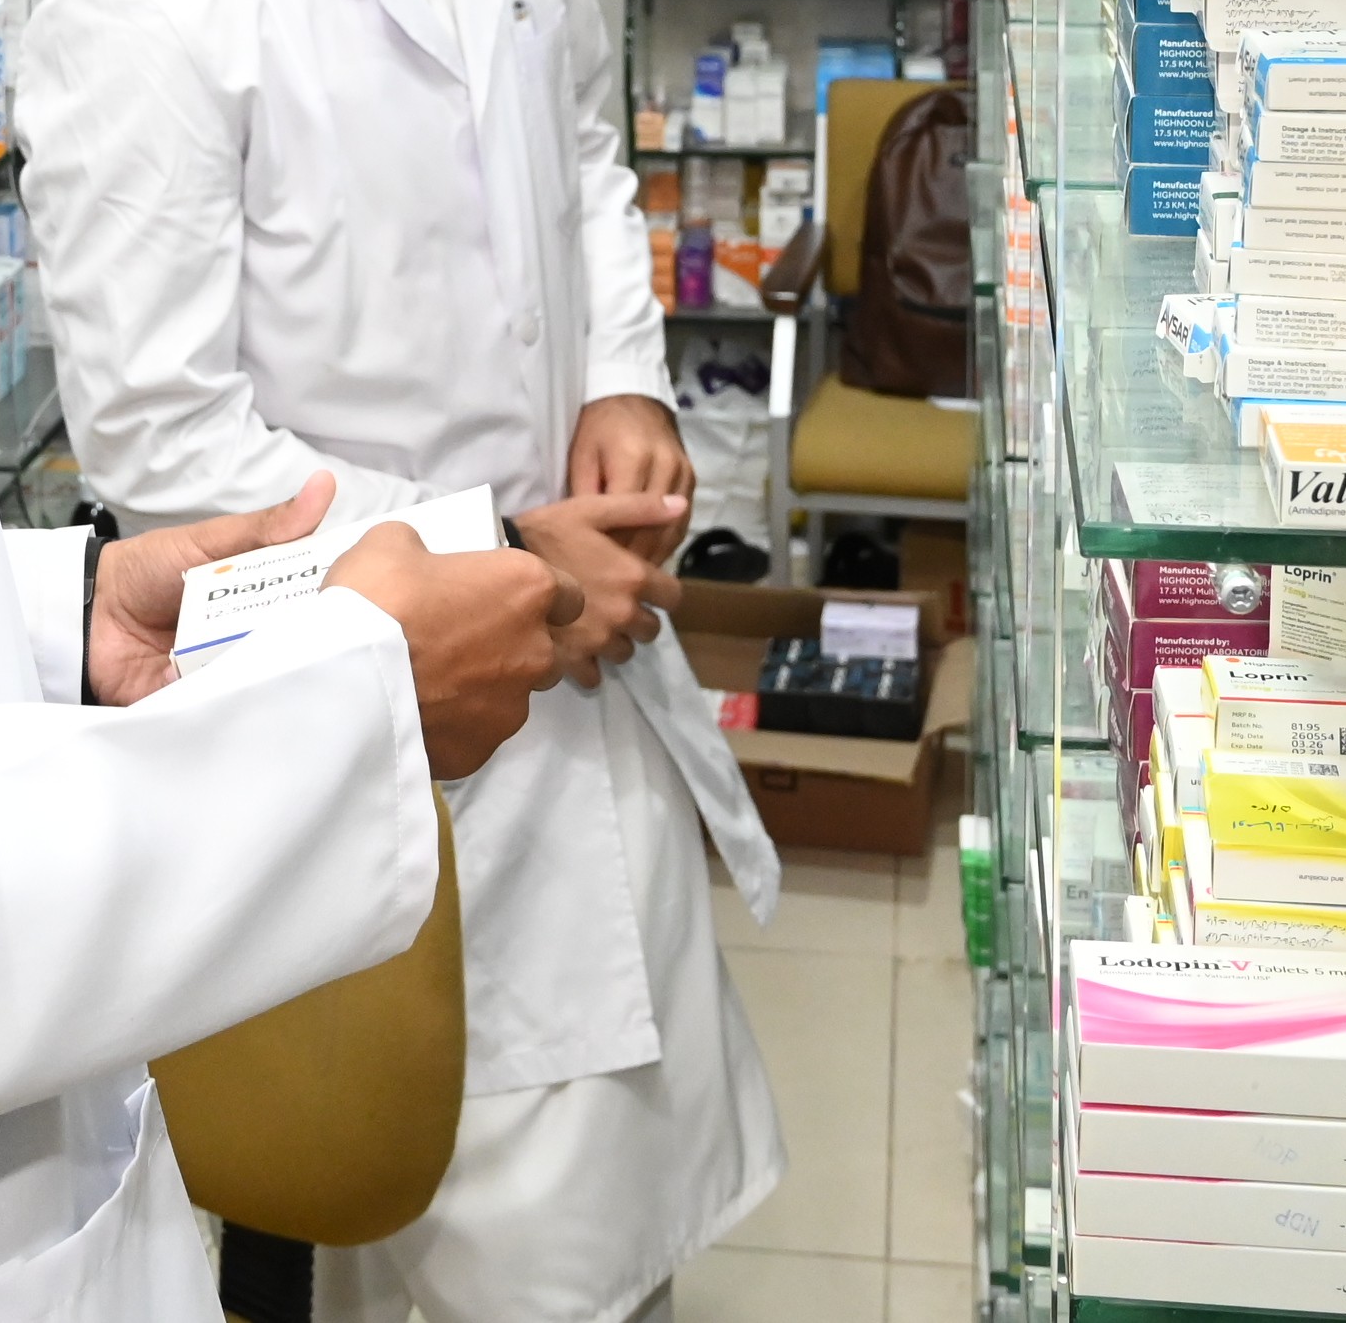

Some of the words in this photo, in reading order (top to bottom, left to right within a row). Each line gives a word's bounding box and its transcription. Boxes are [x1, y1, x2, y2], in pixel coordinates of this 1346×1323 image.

[1160, 310, 1190, 347] AVSAR
[237, 550, 312, 572] Highnoon
[1229, 670, 1308, 681] Loprin
[1292, 732, 1334, 740] 260554
